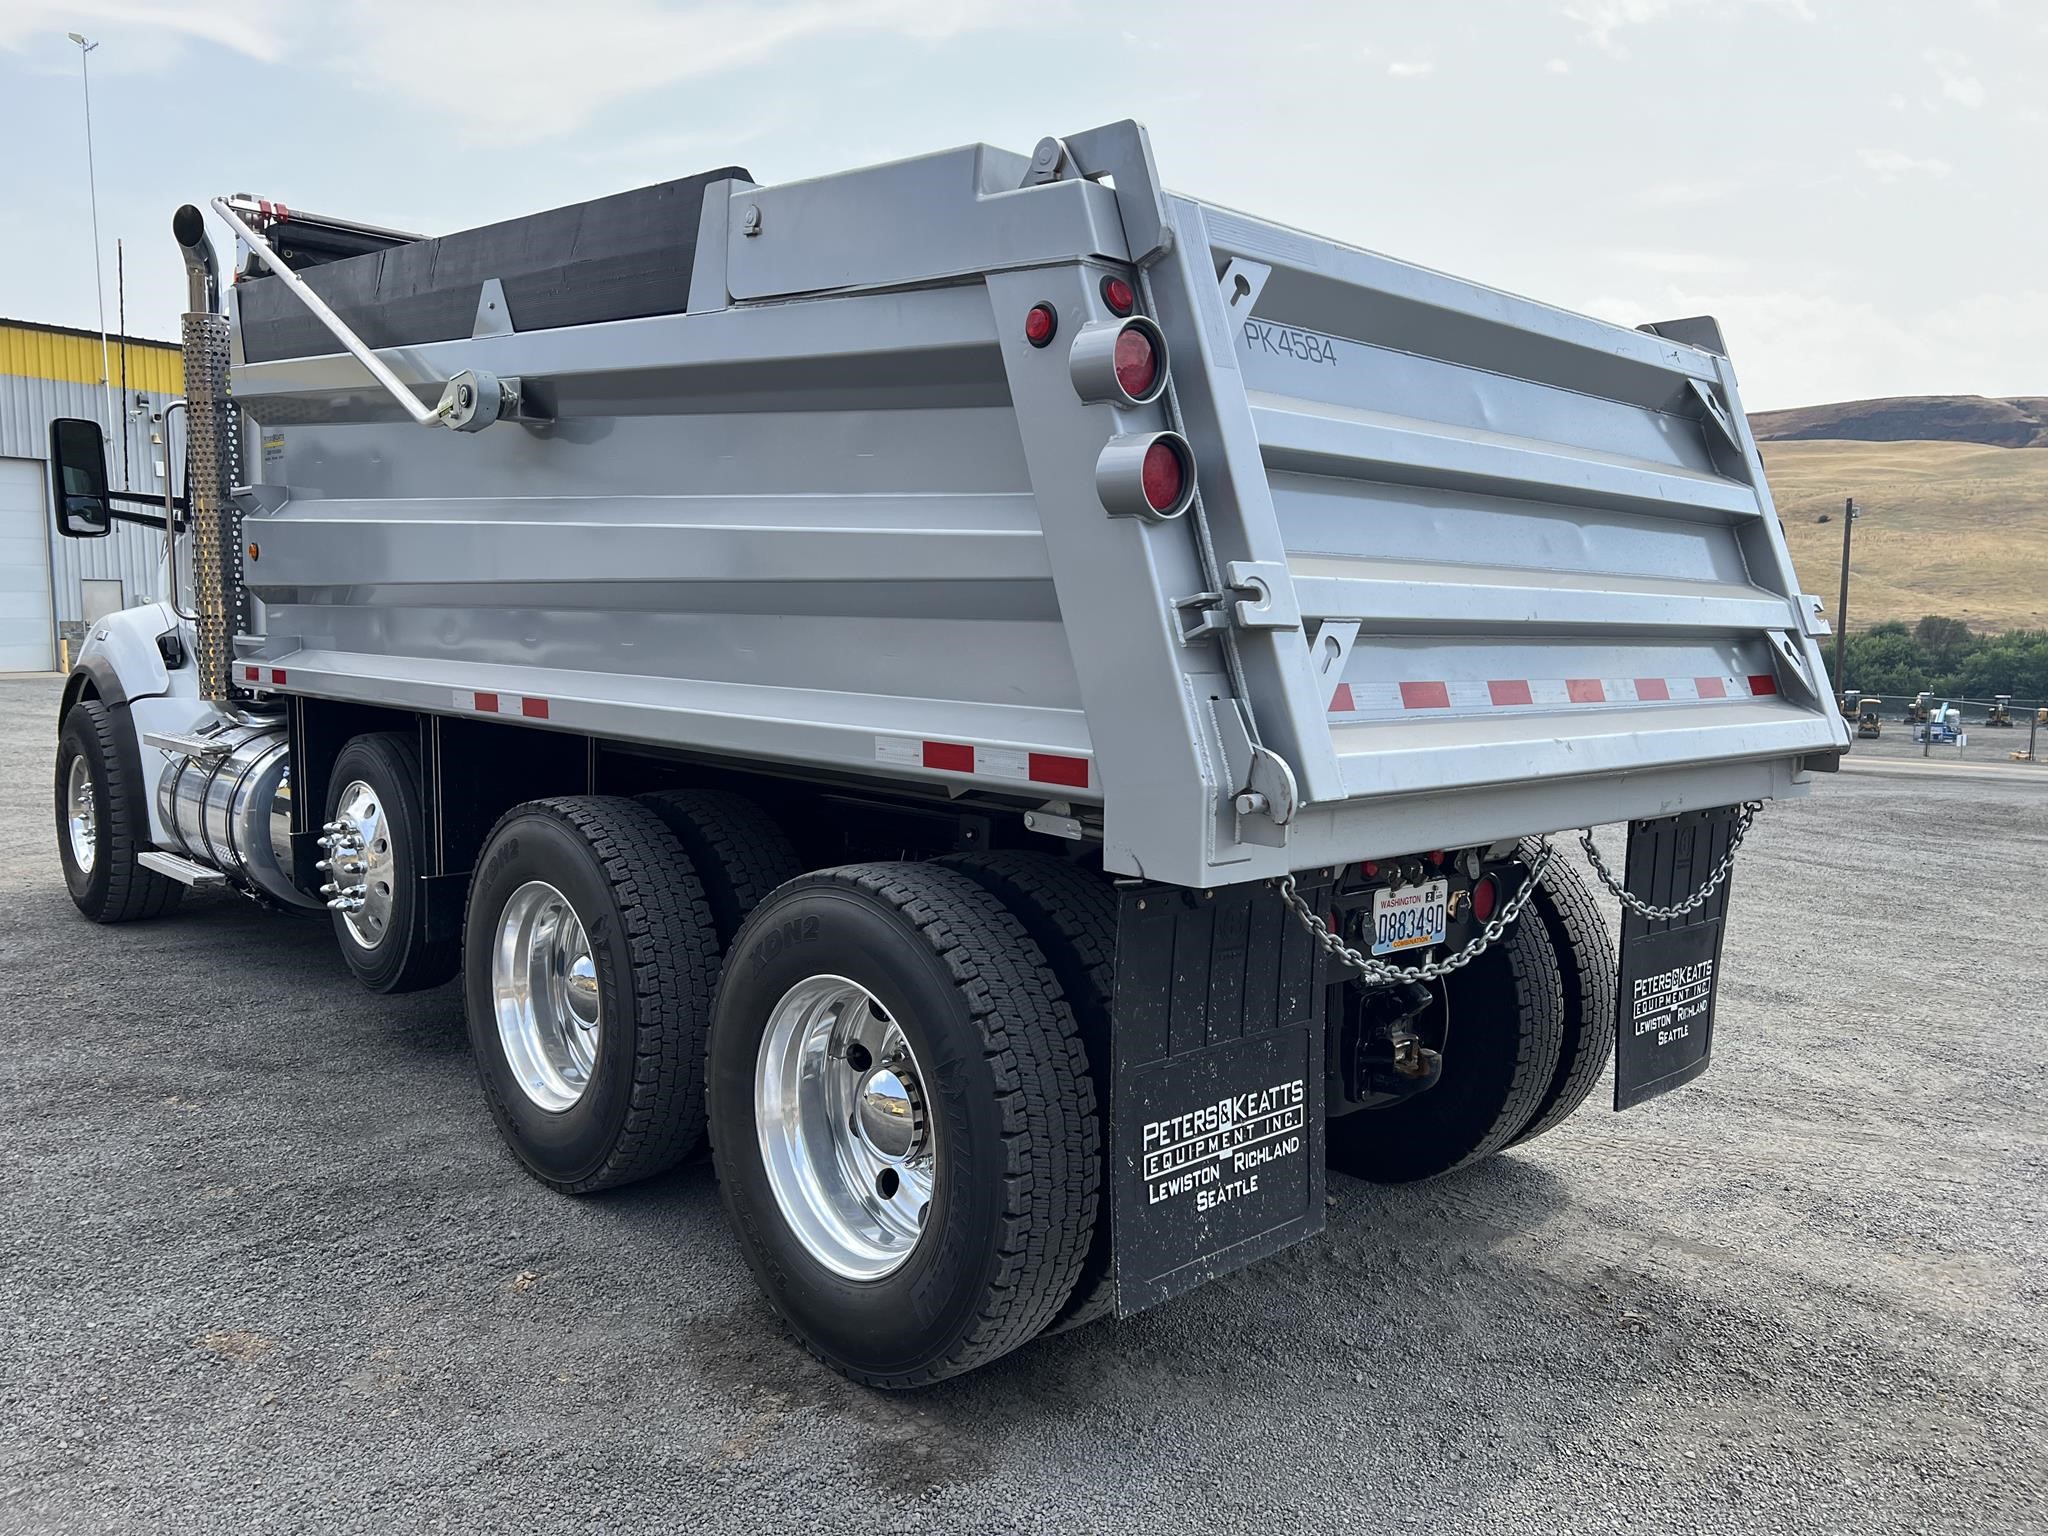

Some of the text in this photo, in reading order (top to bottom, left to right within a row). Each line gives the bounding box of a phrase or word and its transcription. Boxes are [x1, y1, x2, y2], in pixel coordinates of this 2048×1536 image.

[1243, 321, 1337, 366] PK4584
[1380, 895, 1421, 909] WASHINGTON
[1379, 904, 1444, 945] D88349D
[1393, 936, 1429, 948] COMBINATION
[1636, 981, 1708, 1014] EQUIPMENT INC.
[1635, 1000, 1708, 1036] LEWISTON RICHLAND
[1658, 1025, 1689, 1046] SEATTLE
[1151, 1113, 1298, 1174] EQUIPMENT INC.
[1149, 1137, 1300, 1205] LEWISTON RICHLAND
[1196, 1175, 1259, 1212] SEATTLE
